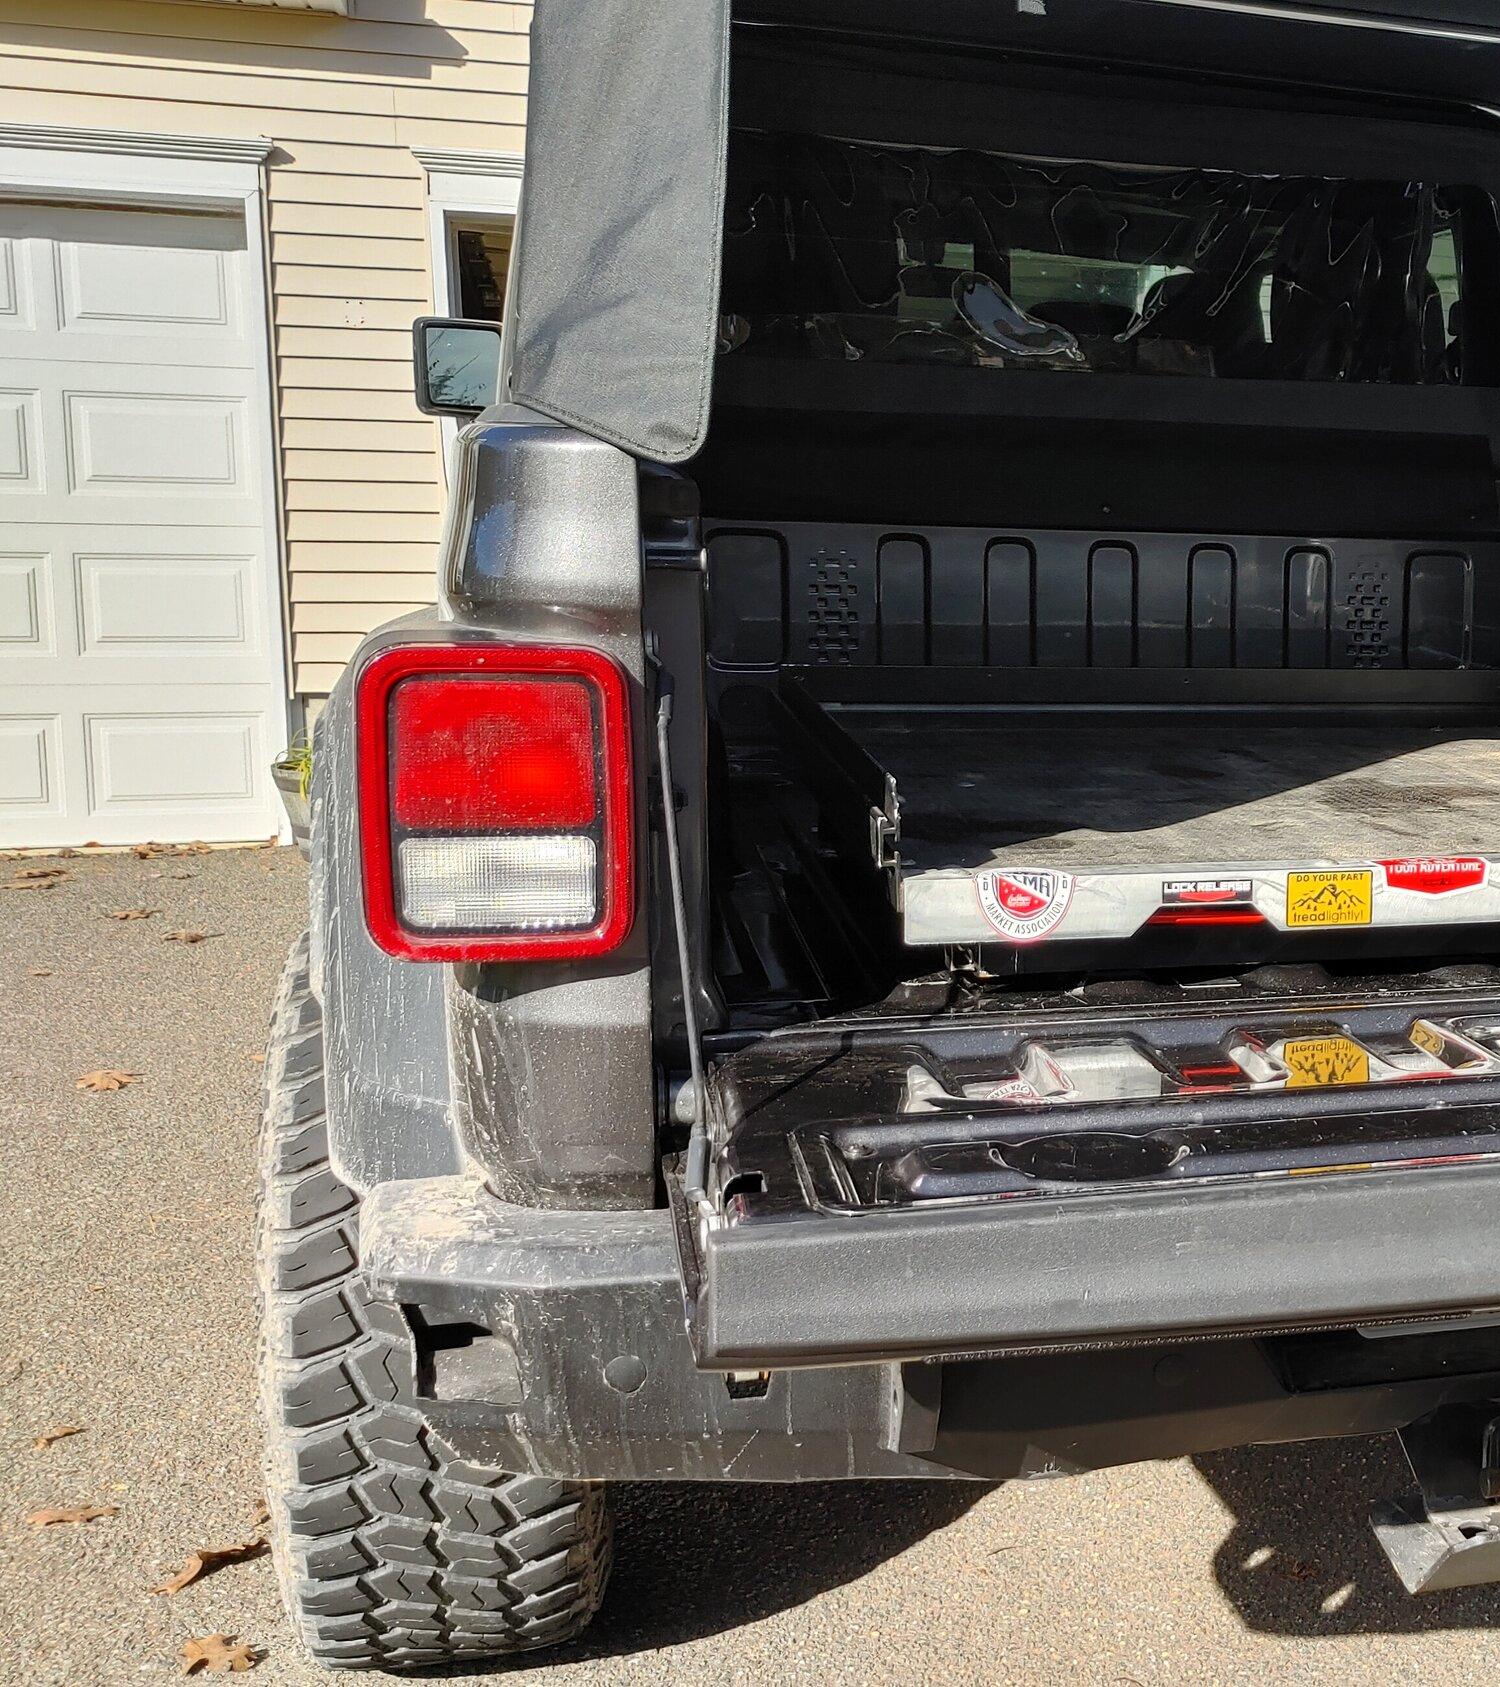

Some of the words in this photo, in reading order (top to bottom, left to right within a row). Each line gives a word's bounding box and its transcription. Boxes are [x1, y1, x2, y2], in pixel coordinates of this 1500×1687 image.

[1296, 874, 1310, 883] DO
[1312, 873, 1338, 882] YOUR
[1341, 873, 1364, 881] PART
[1163, 882, 1197, 894] LOCK
[1197, 881, 1251, 892] RELEASE
[986, 902, 1014, 931] MARKET
[1014, 901, 1064, 934] ASSOCIATION
